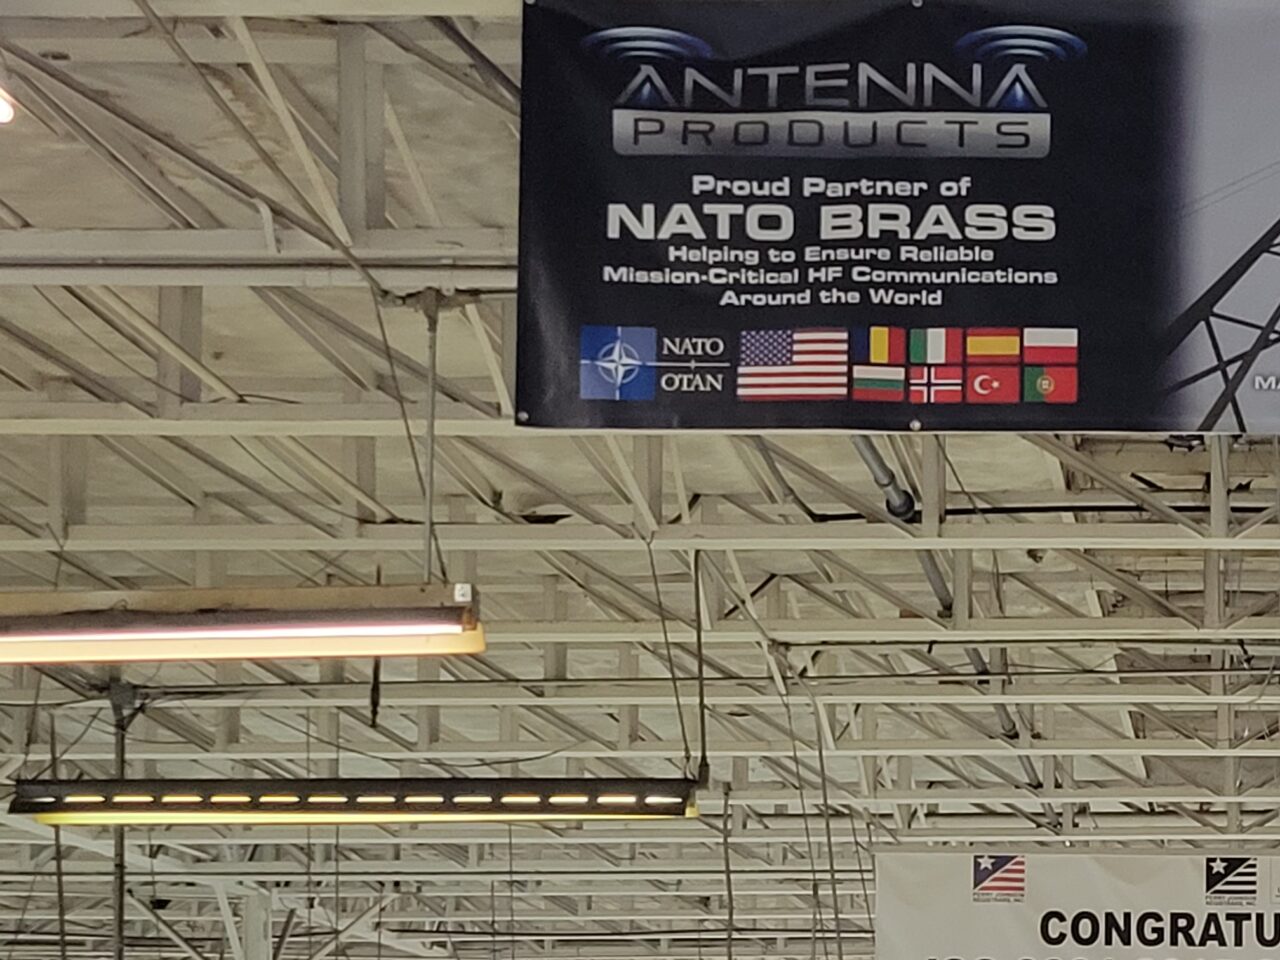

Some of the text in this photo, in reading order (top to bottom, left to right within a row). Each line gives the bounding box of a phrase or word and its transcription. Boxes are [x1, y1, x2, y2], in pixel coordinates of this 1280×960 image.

[616, 62, 1048, 109] ANTENNA
[632, 117, 1031, 149] PRODUCTS
[691, 174, 972, 198] Proud Partner of
[605, 203, 1057, 242] NATO BRASS
[667, 244, 995, 265] Helping to Ensure Reliable
[602, 266, 1059, 286] Mission-Critical HF Communications
[718, 288, 943, 307] Around the World
[661, 336, 725, 357] NATO
[659, 371, 724, 393] OTAN
